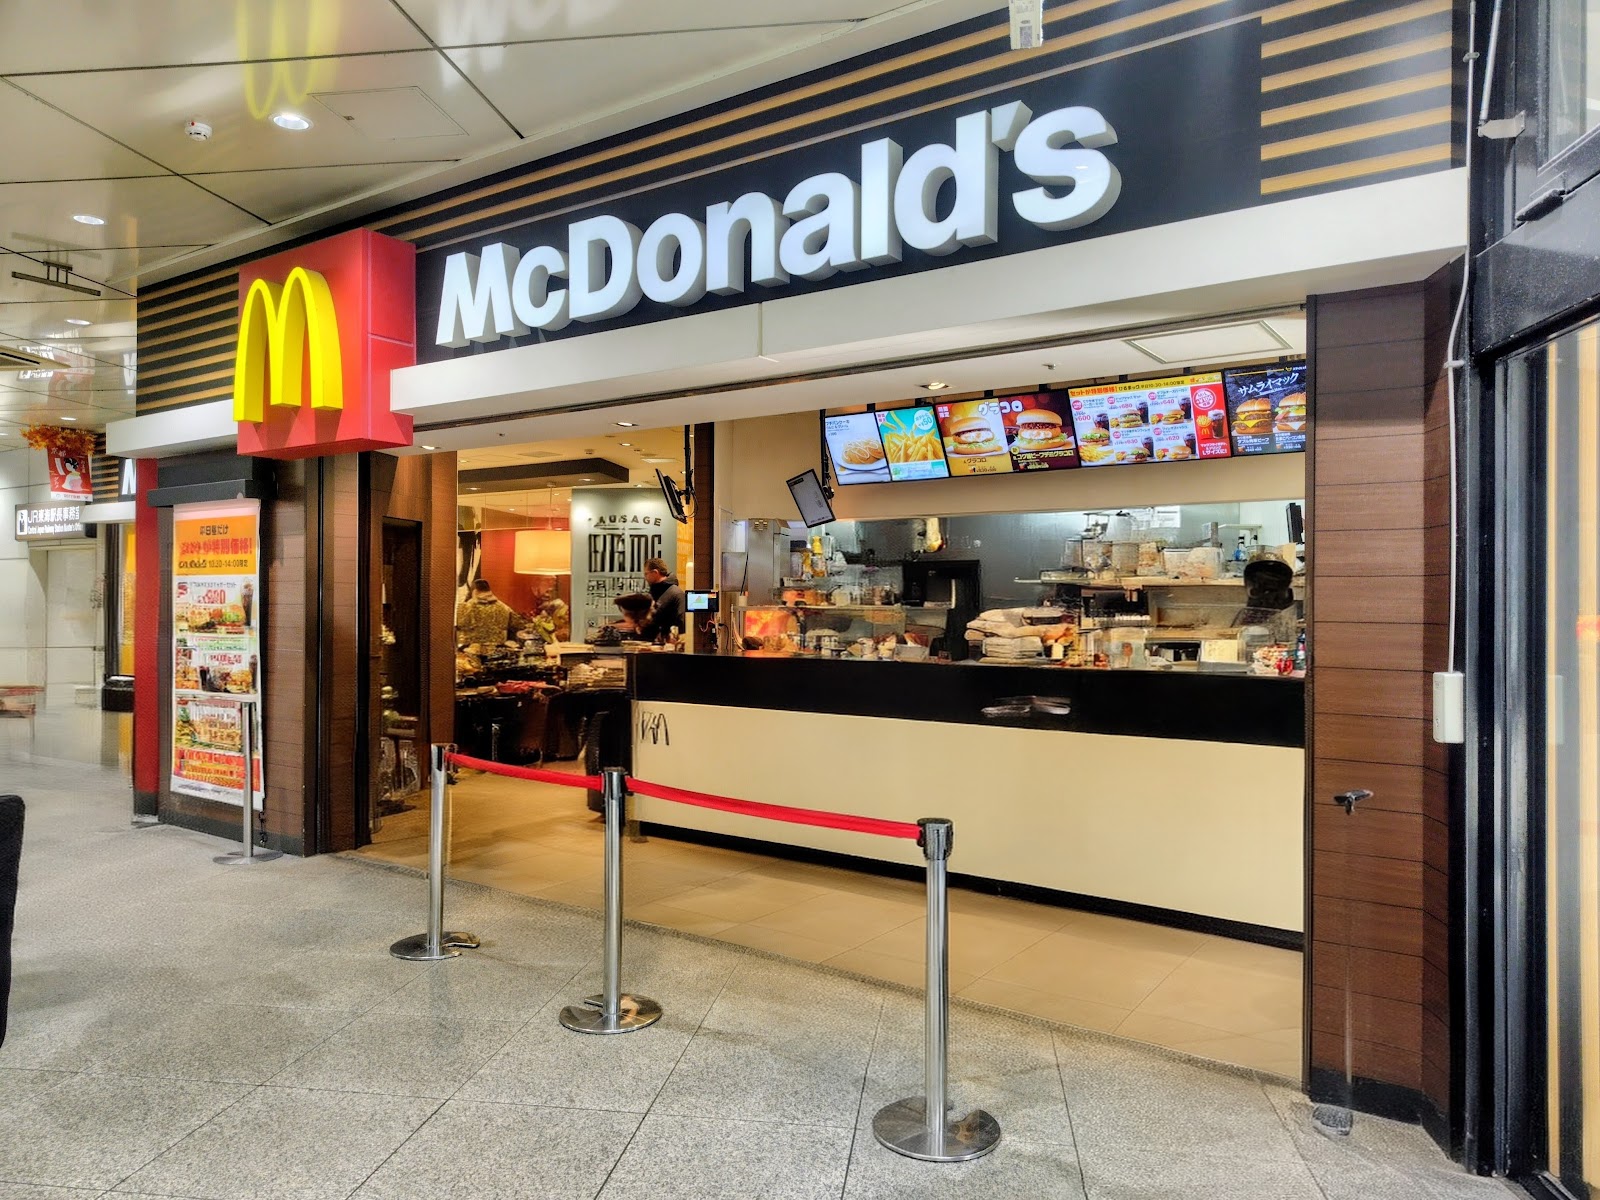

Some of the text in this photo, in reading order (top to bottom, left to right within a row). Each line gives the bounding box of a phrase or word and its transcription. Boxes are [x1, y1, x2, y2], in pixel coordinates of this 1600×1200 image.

[434, 99, 1122, 350] McDonald's
[1237, 372, 1299, 397] サムライマック
[978, 400, 1024, 416] グラコロ
[588, 515, 662, 527] AUSAGE
